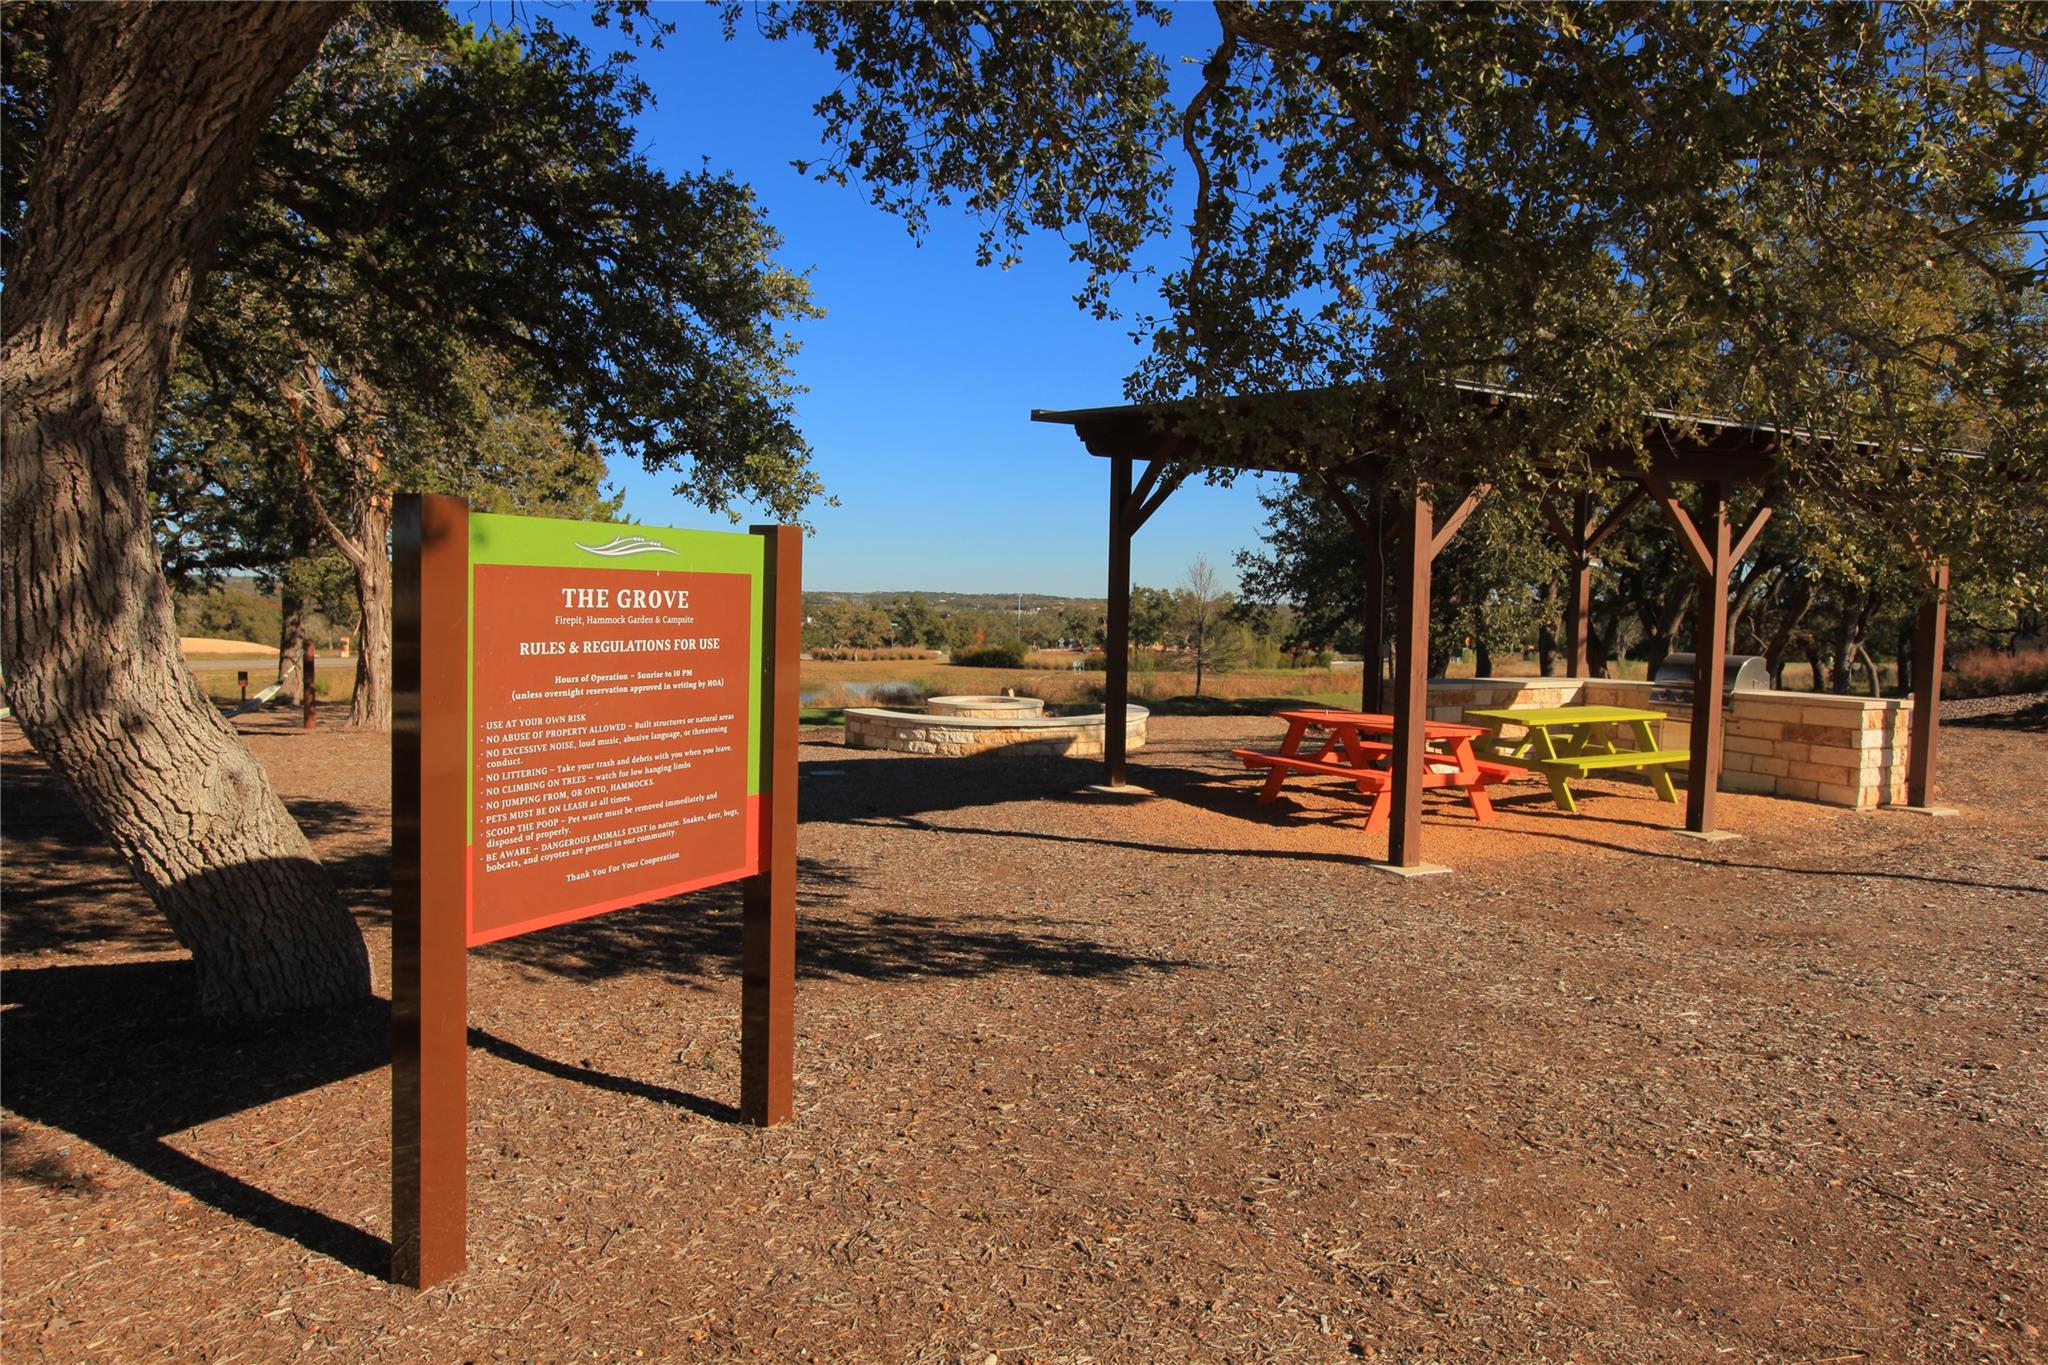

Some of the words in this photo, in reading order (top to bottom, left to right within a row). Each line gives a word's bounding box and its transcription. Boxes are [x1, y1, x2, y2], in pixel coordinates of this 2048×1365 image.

[562, 588, 609, 608] THE
[616, 589, 688, 609] GROVE
[555, 616, 584, 626] Firepit,
[587, 615, 626, 624] Hammock
[627, 616, 654, 624] Garden
[662, 616, 694, 625] Campsite
[520, 641, 565, 656] RULES
[569, 641, 579, 654] &
[583, 639, 671, 653] REGULATIONS
[674, 639, 696, 650] FOR
[699, 638, 720, 650] USE
[512, 690, 543, 701] (unless
[544, 688, 584, 698] overnight
[586, 686, 628, 695] reservation
[630, 683, 662, 694] approved
[672, 681, 697, 690] writing
[698, 680, 706, 689] by
[707, 678, 724, 687] HOA)
[580, 674, 589, 682] of
[590, 673, 628, 683] Operation
[637, 671, 663, 679] Sunrise
[486, 721, 503, 730] USE
[505, 720, 517, 728] AT
[519, 718, 543, 727] YOUR
[545, 716, 566, 724] OWN
[568, 714, 586, 722] RISK
[486, 735, 500, 744] NO
[502, 732, 530, 742] ABUSE
[532, 731, 543, 739] OF
[546, 727, 587, 738] PROPERTY
[589, 723, 626, 734] ALLOWED
[635, 720, 652, 729] Built
[653, 719, 686, 727] structures
[695, 714, 718, 723] natural
[486, 749, 500, 758] NO
[502, 744, 548, 756] EXCESSIVE
[549, 741, 576, 751] NOISE,
[579, 738, 596, 748] loud
[597, 737, 621, 746] music,
[623, 734, 650, 743] abusive
[651, 732, 682, 740] language,
[692, 726, 727, 735] threatening
[486, 758, 523, 768] conduct.
[486, 773, 500, 782] NO
[502, 767, 547, 780] LITTERING
[557, 764, 576, 773] Take
[577, 763, 595, 772] your
[596, 759, 615, 768] trash
[616, 756, 630, 765] and
[631, 754, 653, 764] debris
[654, 752, 669, 760] with
[671, 752, 683, 760] you
[486, 787, 500, 796] NO
[502, 781, 545, 794] CLIMBING
[547, 779, 560, 788] ON
[562, 776, 586, 785] TREES
[595, 771, 617, 780] watch
[644, 765, 672, 774] hanging
[486, 801, 500, 810] NO
[502, 795, 541, 809] JUMPING
[543, 791, 569, 801] FROM,
[571, 789, 582, 797] OR
[584, 785, 608, 795] ONTO,
[486, 813, 507, 824] PETS
[509, 809, 534, 820] MUST
[536, 807, 546, 816] BE
[548, 805, 561, 814] ON
[563, 801, 588, 812] LEASH
[599, 797, 608, 806] all
[486, 826, 515, 838] SCOOP
[517, 822, 534, 833] THE
[536, 819, 559, 829] POOP
[568, 816, 580, 824] Pet
[582, 813, 603, 821] waste
[604, 809, 623, 817] must
[634, 800, 664, 812] removed
[665, 794, 705, 807] immediately
[706, 792, 717, 800] and
[486, 834, 523, 848] disposed
[525, 832, 534, 841] of
[536, 827, 571, 841] properly.
[486, 853, 497, 862] BE
[499, 846, 531, 860] AWARE
[541, 835, 590, 851] DANGEROUS
[592, 829, 626, 842] ANIMALS
[628, 825, 648, 835] EXIST
[658, 820, 680, 830] nature.
[486, 860, 521, 872] bobcats,
[523, 854, 538, 865] and
[540, 850, 570, 862] coyotes
[585, 842, 612, 855] present
[566, 870, 590, 882] Thank
[622, 862, 638, 870] Your
[640, 853, 679, 866] Cooperation
